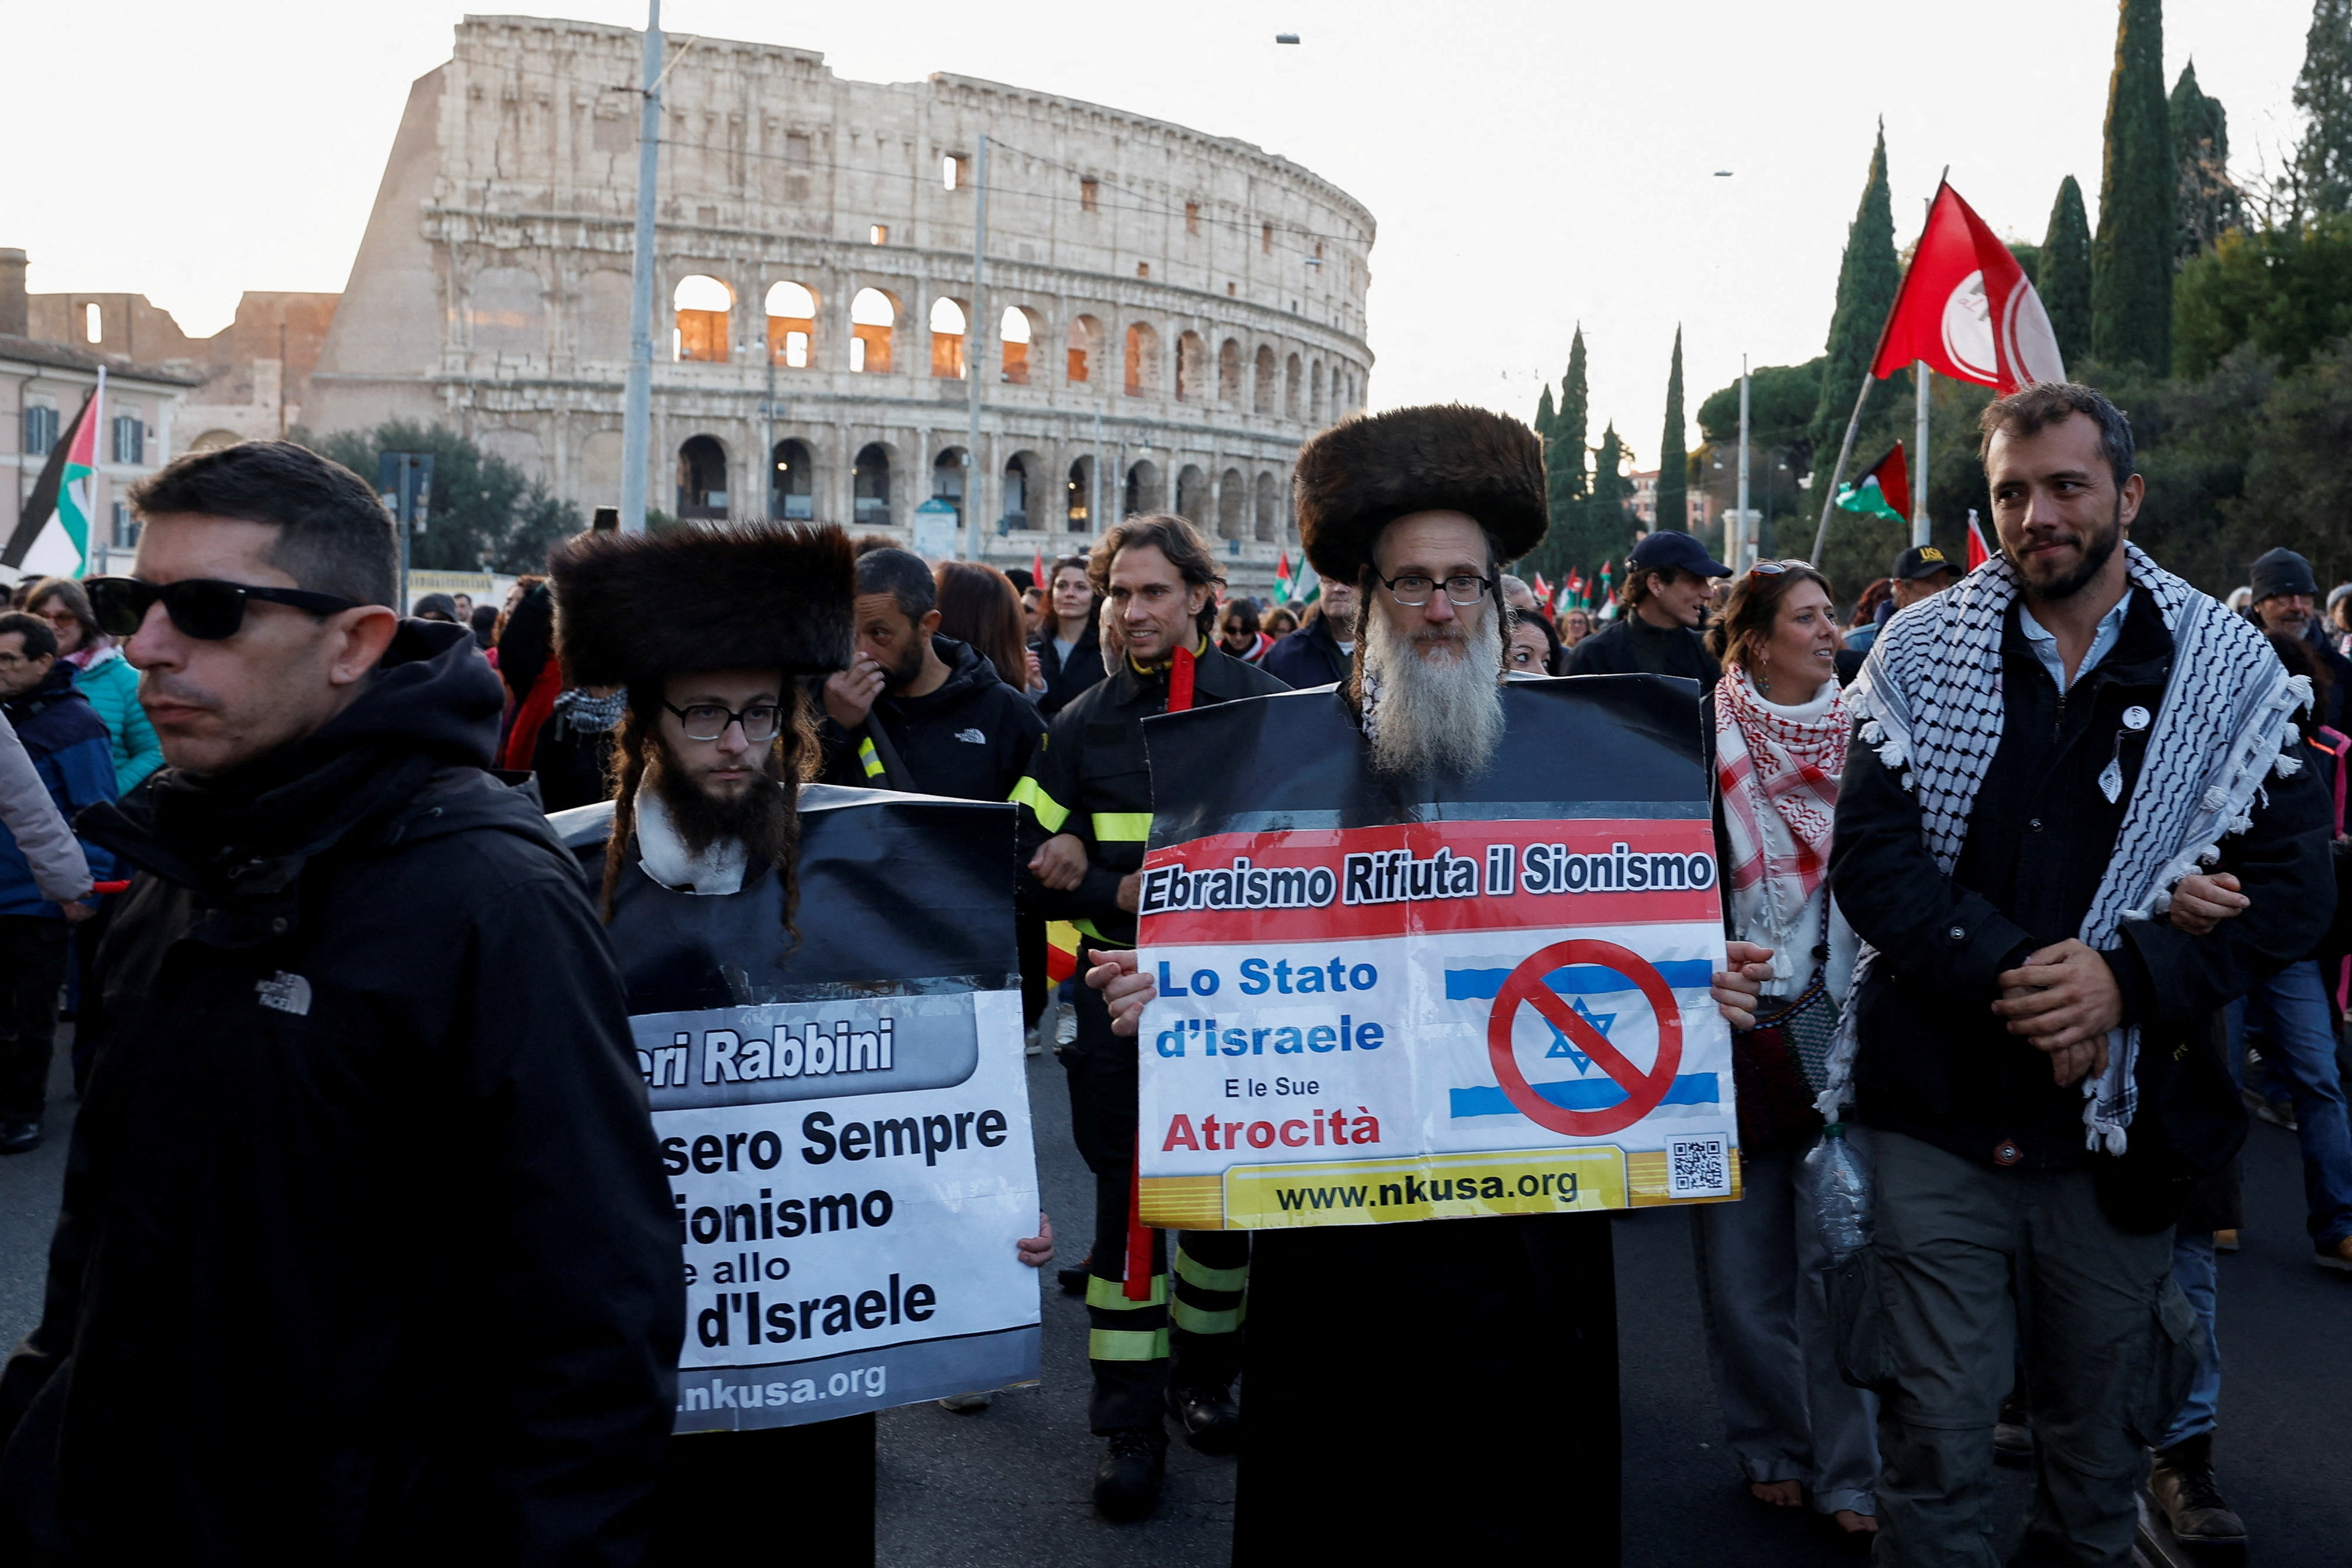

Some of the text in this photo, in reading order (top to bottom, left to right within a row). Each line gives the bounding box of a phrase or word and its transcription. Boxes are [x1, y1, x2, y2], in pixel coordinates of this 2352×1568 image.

[1140, 842, 1715, 915] Ebraismo Rifiuta il Sionismo
[1158, 956, 1378, 997] Lo Stato
[703, 1017, 894, 1086] Rabbini
[1226, 1076, 1319, 1098] E le Sue
[802, 1109, 1008, 1166] Sempre
[1162, 1106, 1380, 1152] Atrocità
[1277, 1172, 1578, 1212] www.nkusa.org
[713, 1251, 791, 1284] allo
[698, 1272, 937, 1348] d'Israele
